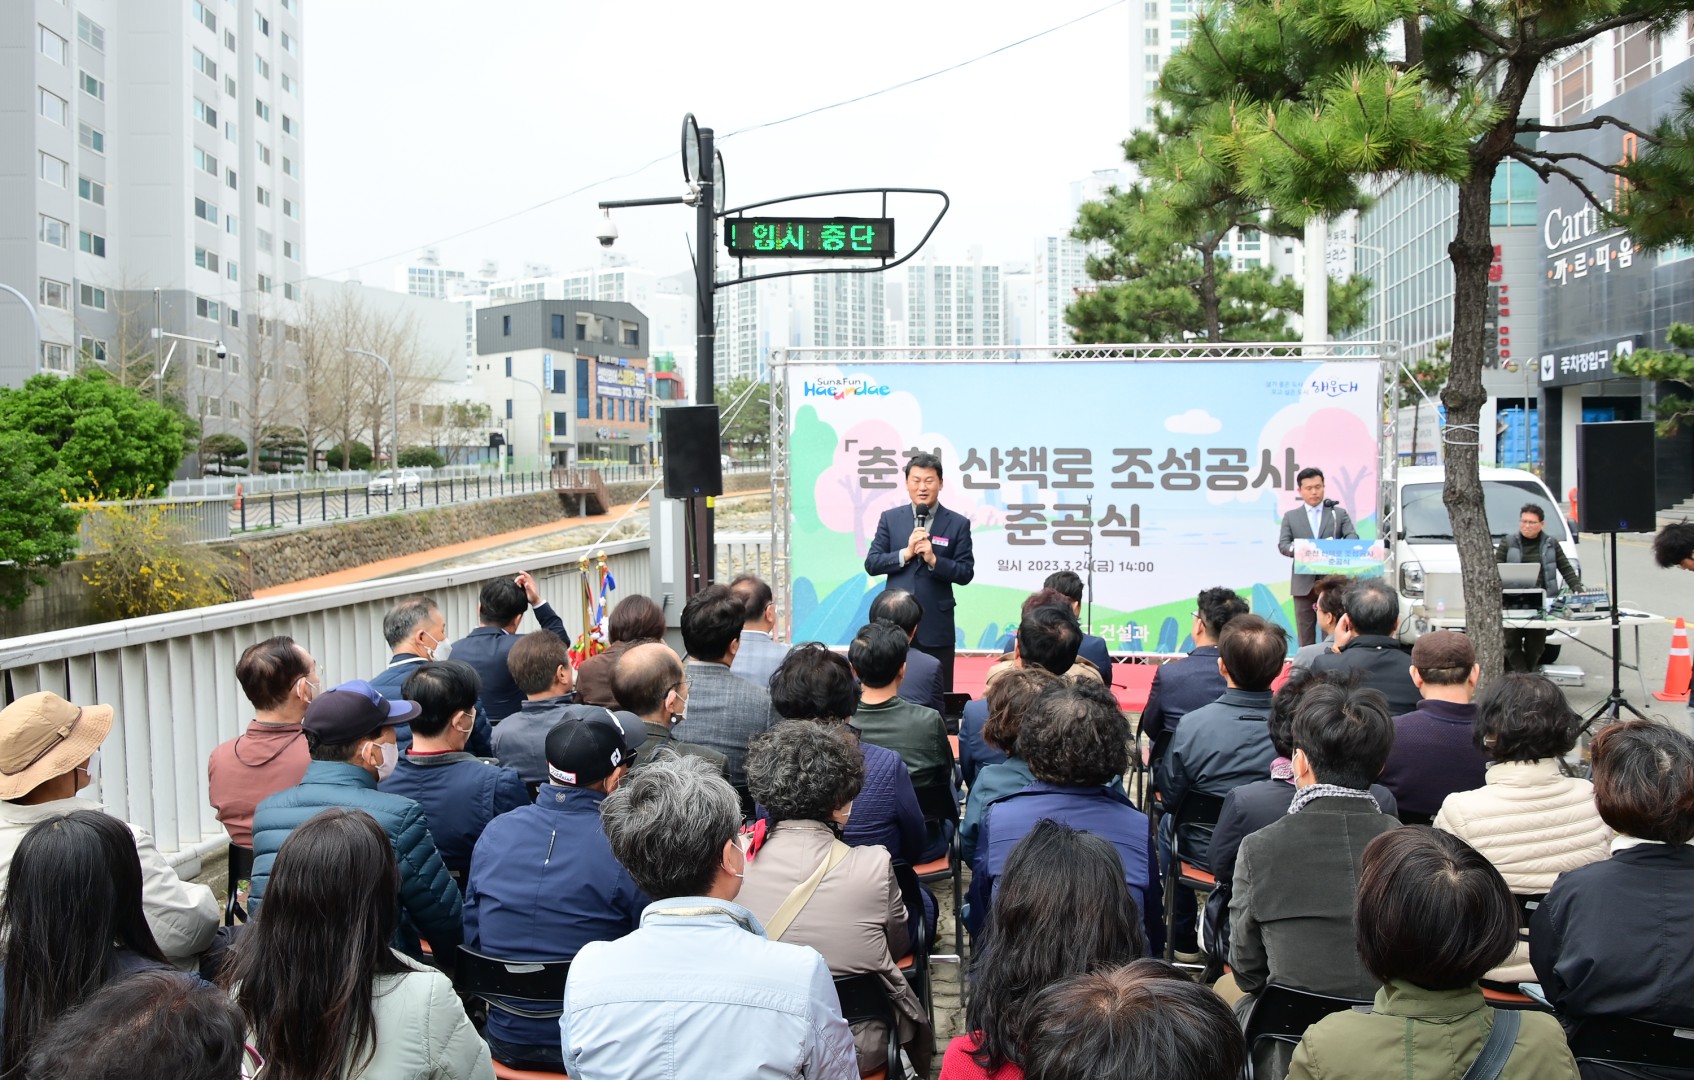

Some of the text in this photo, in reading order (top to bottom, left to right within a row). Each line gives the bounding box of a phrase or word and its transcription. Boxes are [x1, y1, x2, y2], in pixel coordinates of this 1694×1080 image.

[821, 224, 876, 251] 중단
[1560, 349, 1610, 374] 주차장입구
[803, 381, 891, 400] Haeundae
[816, 377, 862, 386] Sun&Fun
[1311, 379, 1359, 398] 해운대
[959, 446, 1095, 491] 산책로
[1004, 503, 1141, 547] 준공식
[997, 560, 1022, 572] 일시
[1119, 561, 1154, 573] 14:00
[1099, 623, 1150, 643] 건설과
